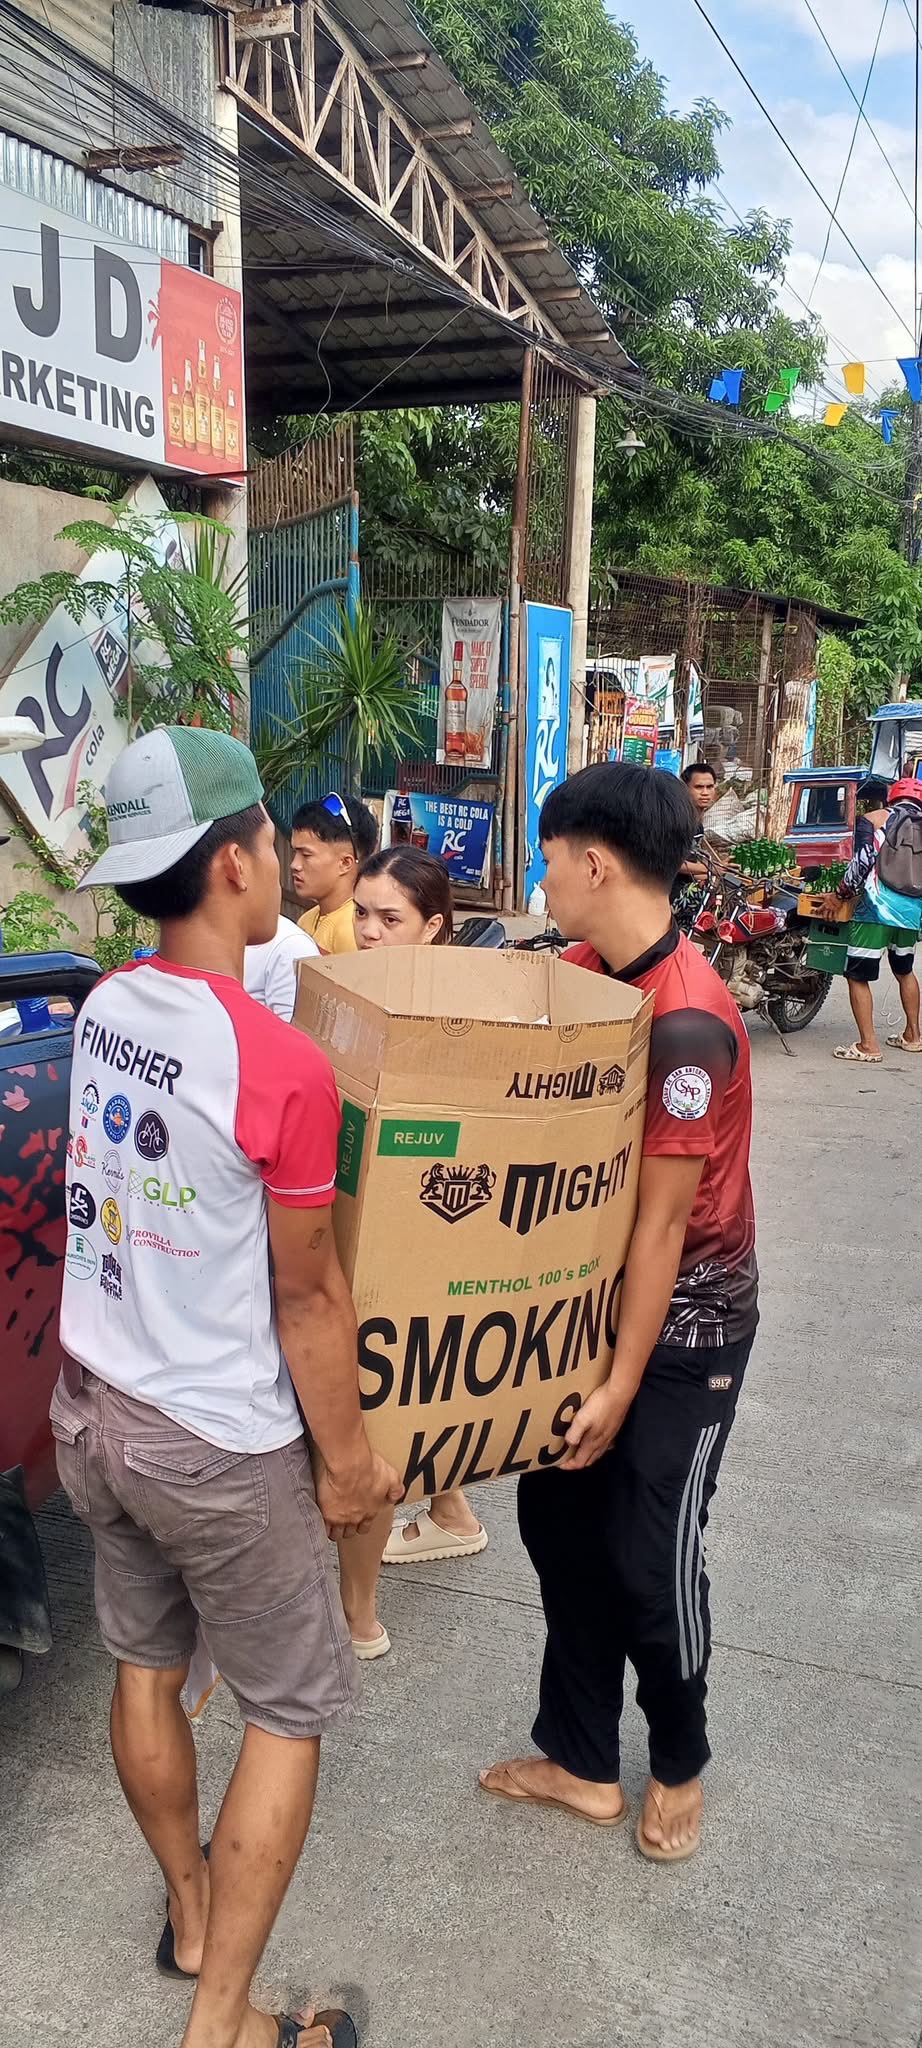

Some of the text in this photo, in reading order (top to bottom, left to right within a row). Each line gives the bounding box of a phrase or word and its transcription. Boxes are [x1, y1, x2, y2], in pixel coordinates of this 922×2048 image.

[13, 223, 142, 363] J D
[0, 350, 155, 438] RKETING
[452, 617, 489, 627] FUNDADOR
[16, 641, 92, 820] RC
[85, 724, 105, 767] cola
[533, 720, 560, 799] RC
[398, 798, 406, 807] RC
[425, 801, 488, 820] THE BEST RC COLA
[438, 815, 473, 831] IS A COLD
[441, 830, 466, 854] RC
[80, 1017, 182, 1095] FINISHER
[505, 1061, 598, 1100] MIGHTY
[340, 1121, 356, 1176] REJUV
[393, 1132, 445, 1145] REJUV
[143, 1177, 197, 1208] GLP
[499, 1141, 633, 1236] MIGHTY
[133, 1239, 200, 1258] CONSTRUCTION
[447, 1276, 532, 1296] MENTHOL
[578, 1256, 601, 1279] BOX
[711, 1378, 732, 1389] 5917
[394, 1392, 581, 1506] KILLS
